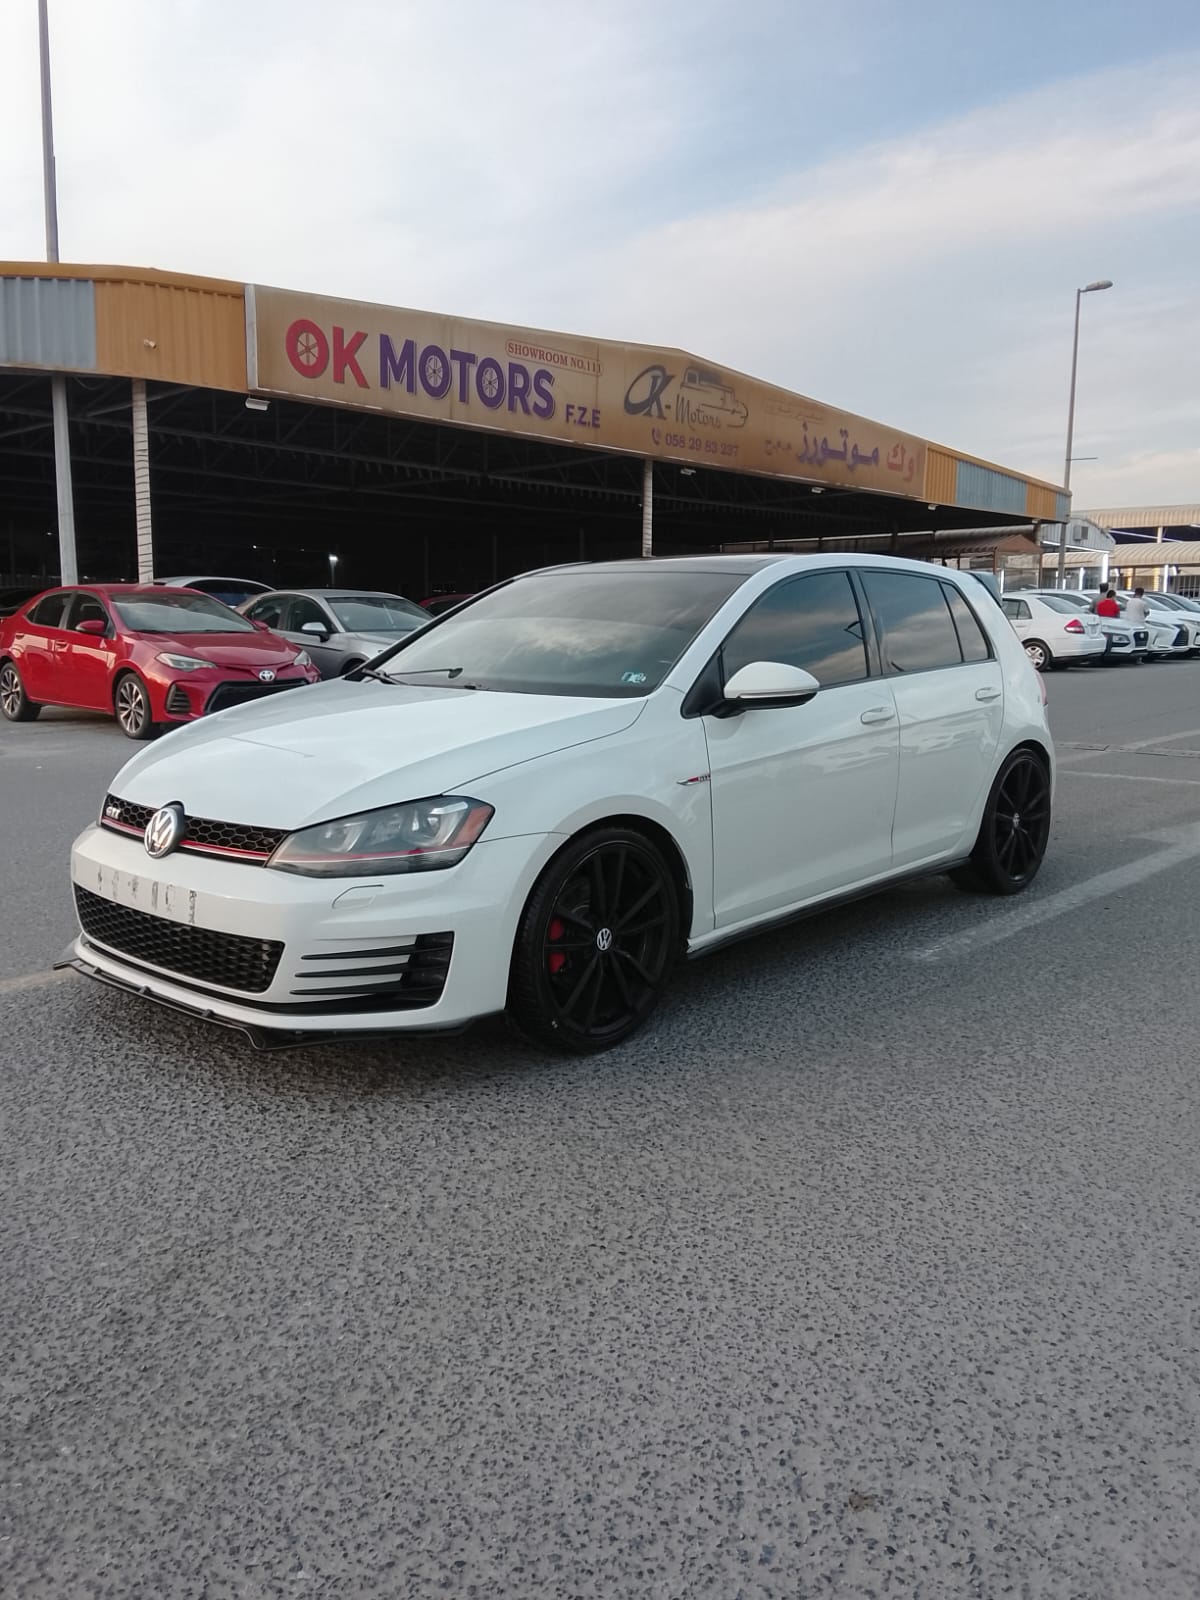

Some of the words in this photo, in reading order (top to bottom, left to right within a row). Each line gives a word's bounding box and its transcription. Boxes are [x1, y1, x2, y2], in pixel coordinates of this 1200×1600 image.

[285, 319, 370, 389] OK
[379, 333, 555, 420] MOTORS
[508, 342, 568, 366] SHOWROOM
[796, 421, 879, 472] موتورز
